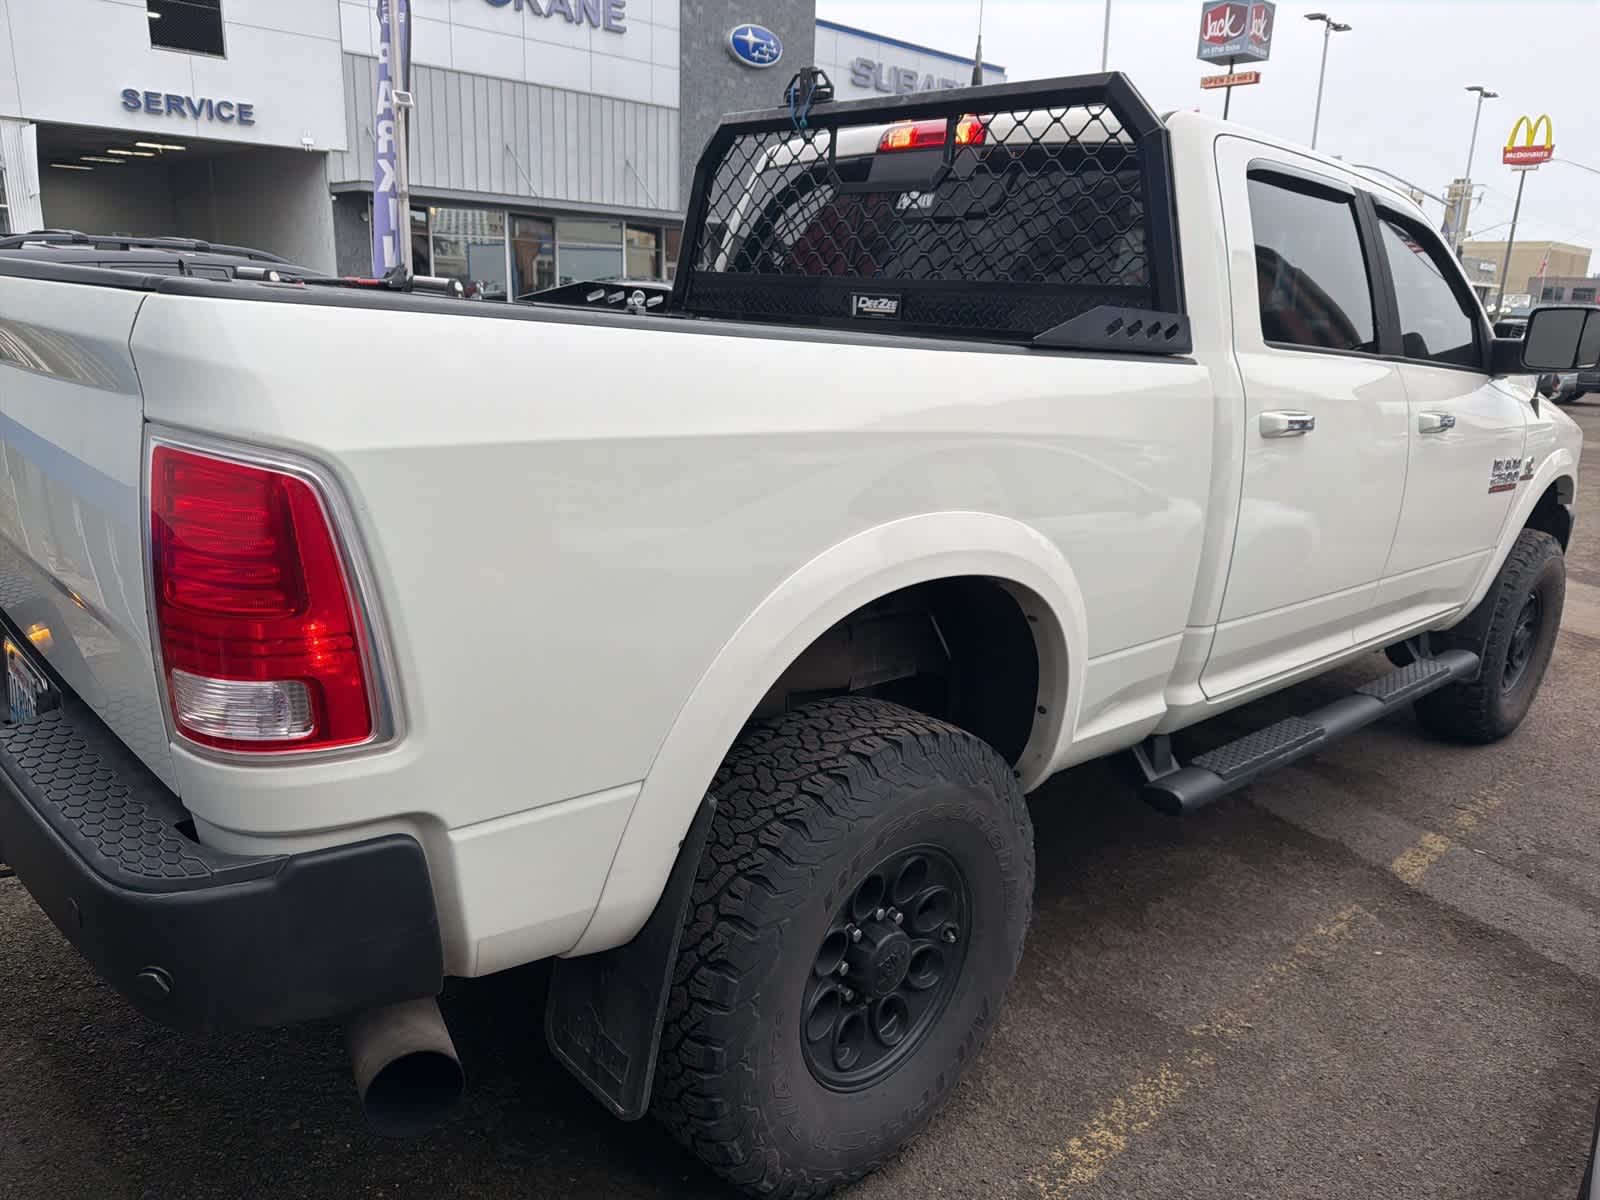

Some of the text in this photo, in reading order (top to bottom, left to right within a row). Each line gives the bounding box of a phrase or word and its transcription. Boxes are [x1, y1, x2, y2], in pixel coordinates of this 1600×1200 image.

[1203, 6, 1245, 40] Jack
[851, 57, 966, 96] SUBA
[1201, 76, 1224, 87] OPEN
[121, 88, 256, 126] SERVICE
[1493, 459, 1521, 472] RAM
